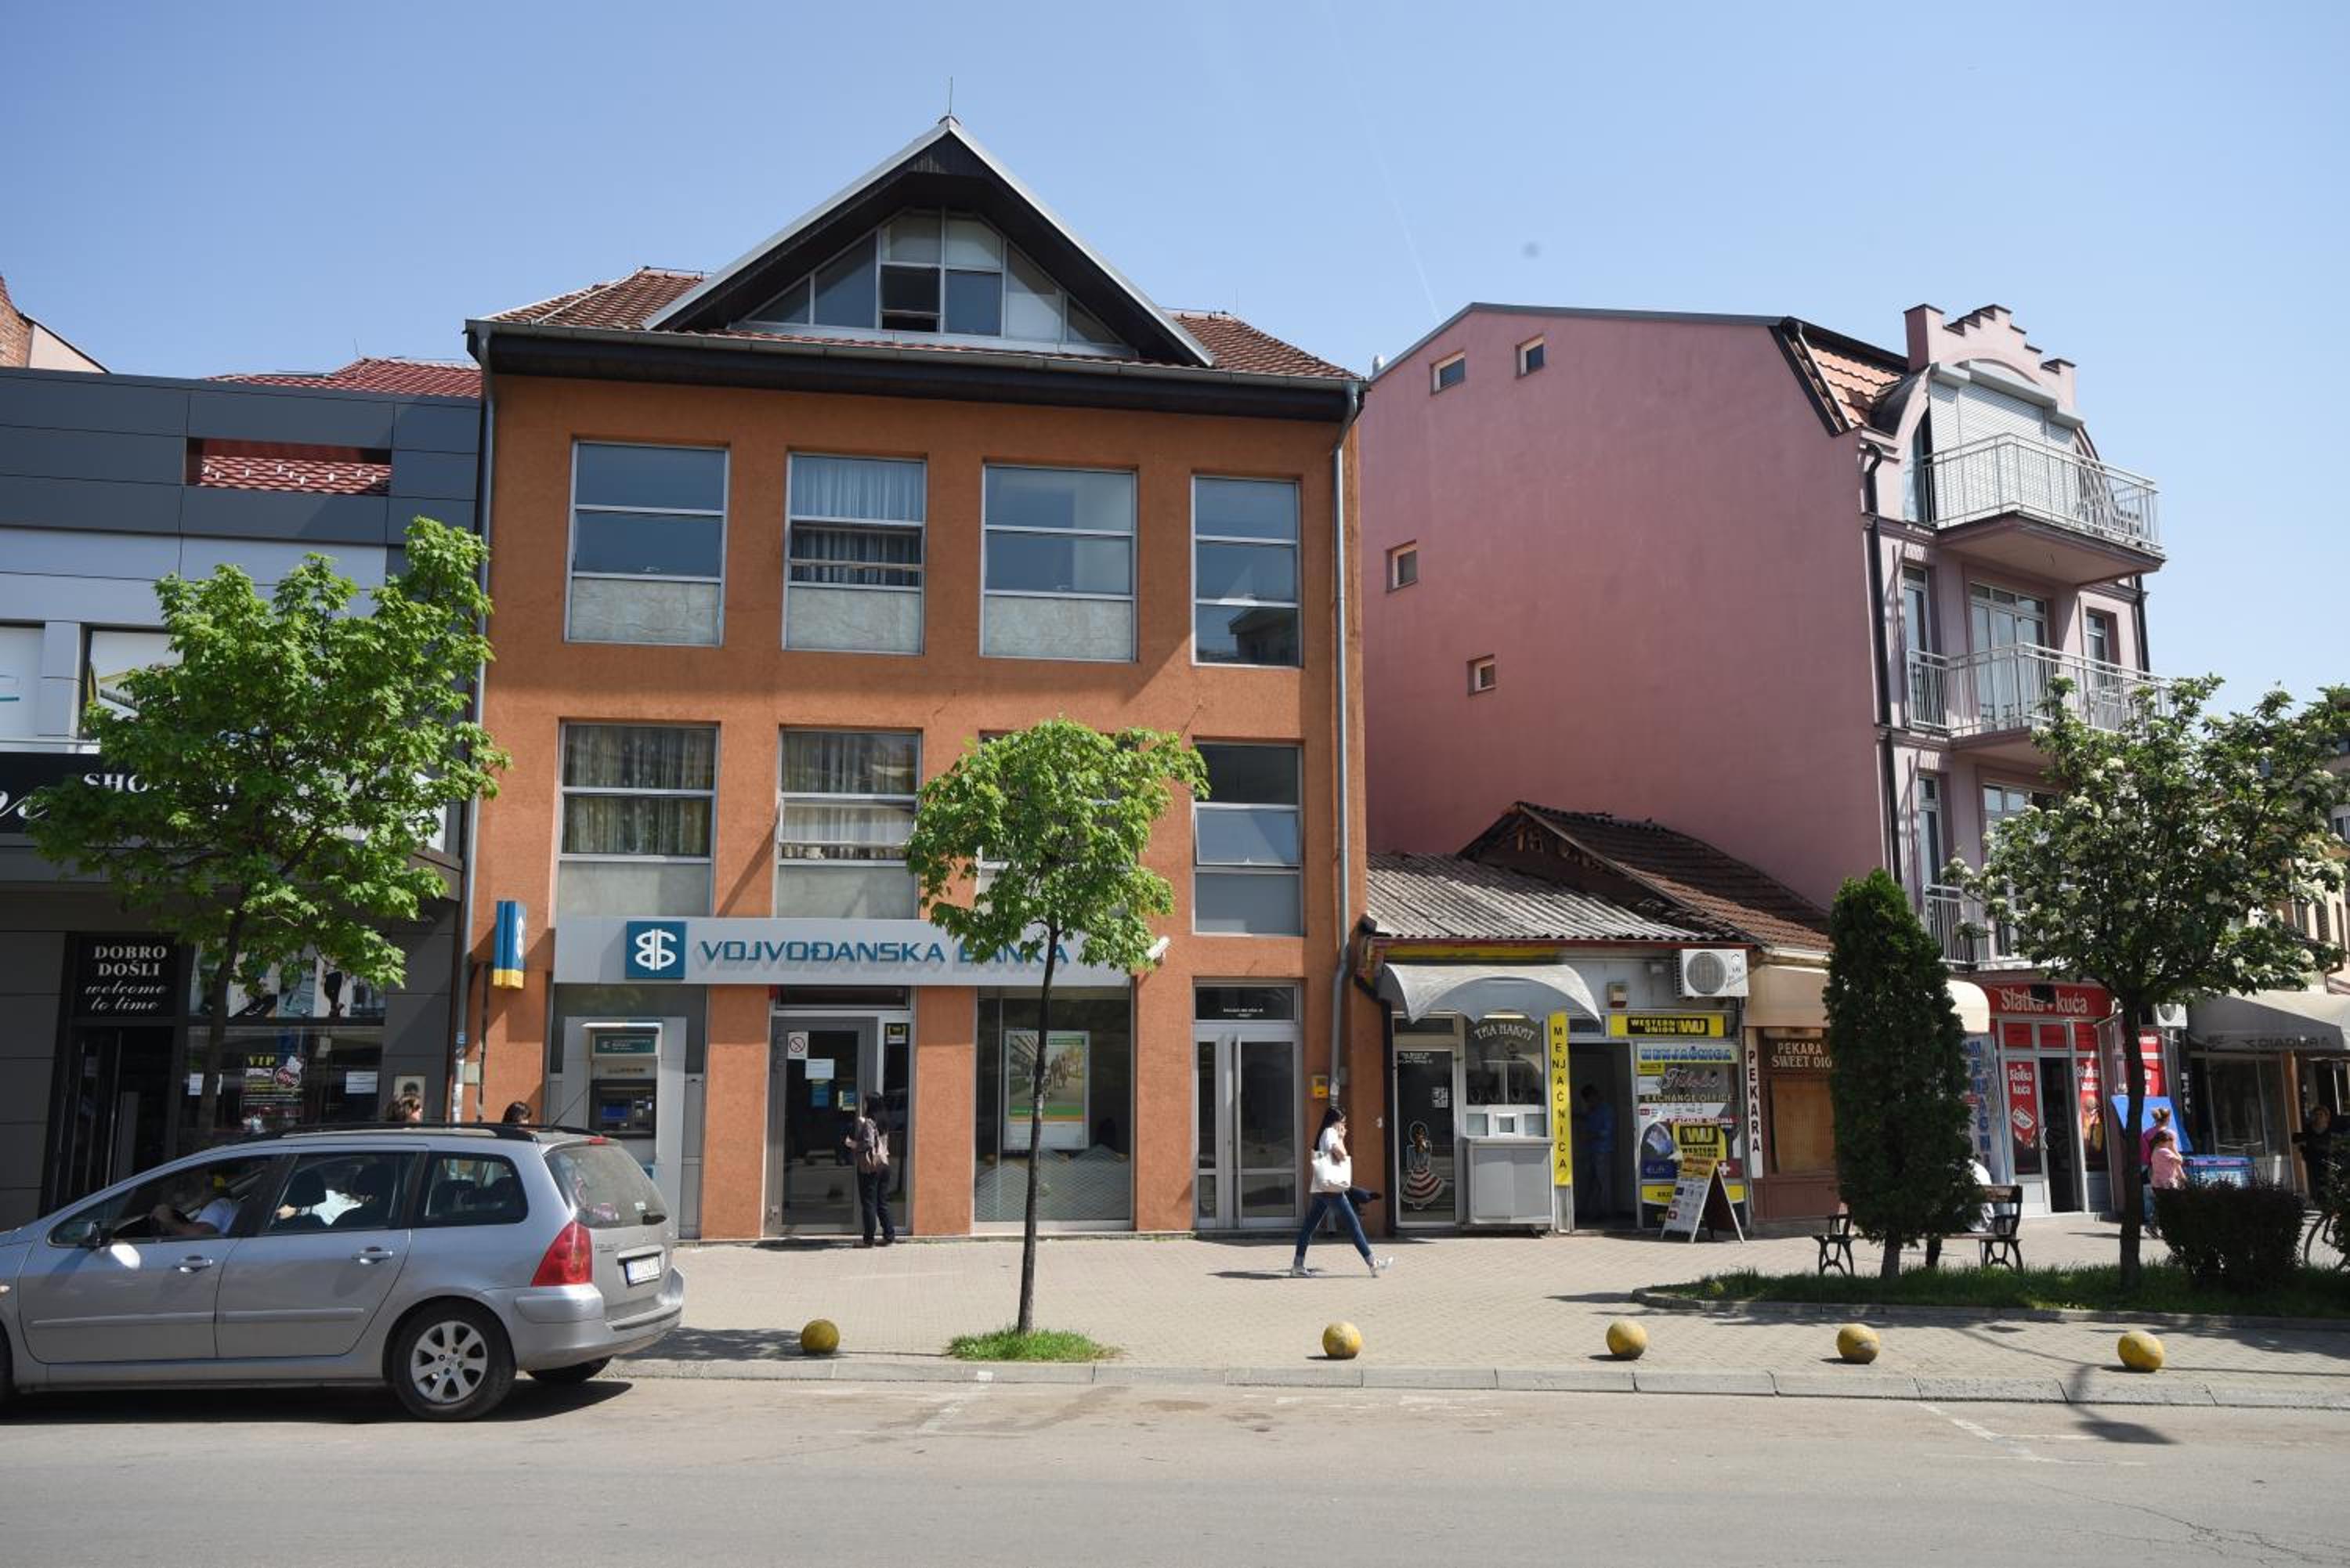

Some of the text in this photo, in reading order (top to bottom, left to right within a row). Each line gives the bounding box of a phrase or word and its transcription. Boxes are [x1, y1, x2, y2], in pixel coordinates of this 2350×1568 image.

[95, 945, 167, 959] DOBRO
[701, 941, 945, 963] VOJVOĐANSKA
[98, 959, 160, 976] DOŠLI
[85, 980, 166, 994] welcome
[91, 995, 158, 1010] to time
[2055, 989, 2088, 1013] kuća
[1679, 1019, 1706, 1034] WU
[1640, 1046, 1733, 1060] MENJAČNICA
[1777, 1042, 1823, 1055] PEKARA
[248, 1056, 275, 1067] VIP
[1771, 1055, 1810, 1068] SWEET
[1748, 1050, 1761, 1152] PEKARA
